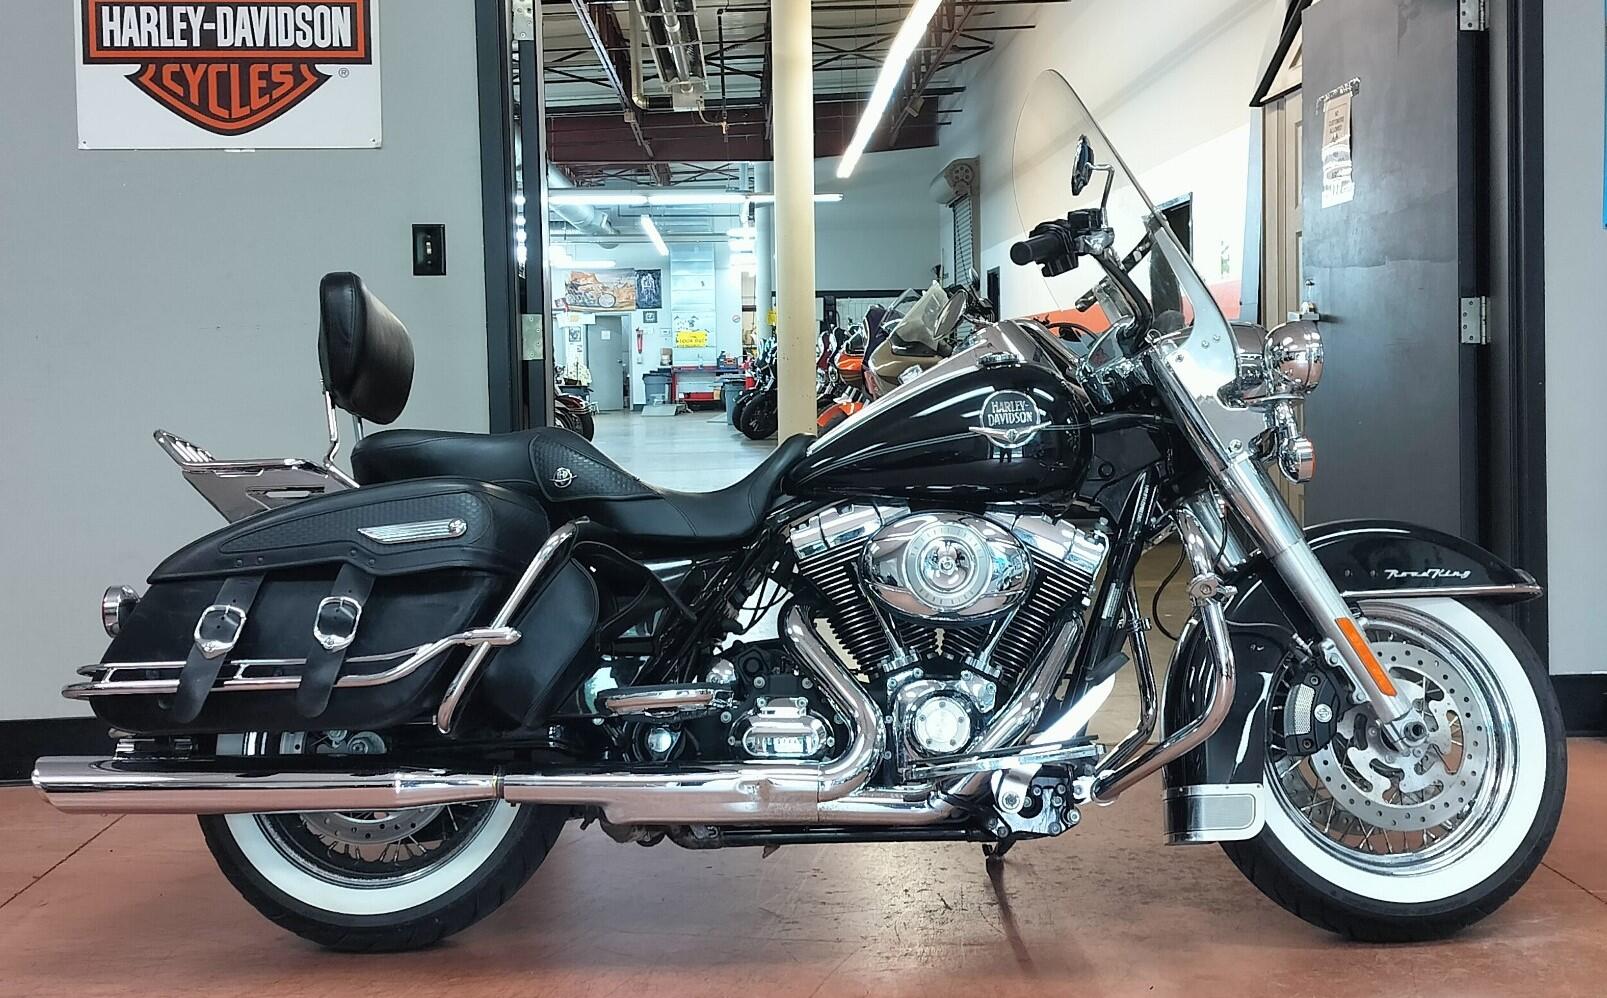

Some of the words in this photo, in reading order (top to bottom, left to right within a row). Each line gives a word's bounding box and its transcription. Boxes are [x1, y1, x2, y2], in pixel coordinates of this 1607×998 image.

[101, 5, 352, 48] HARLEY-DAVIDSON
[162, 64, 295, 119] CYCLES
[987, 411, 1033, 426] DAVIDSON
[991, 401, 1029, 413] HARLEY-
